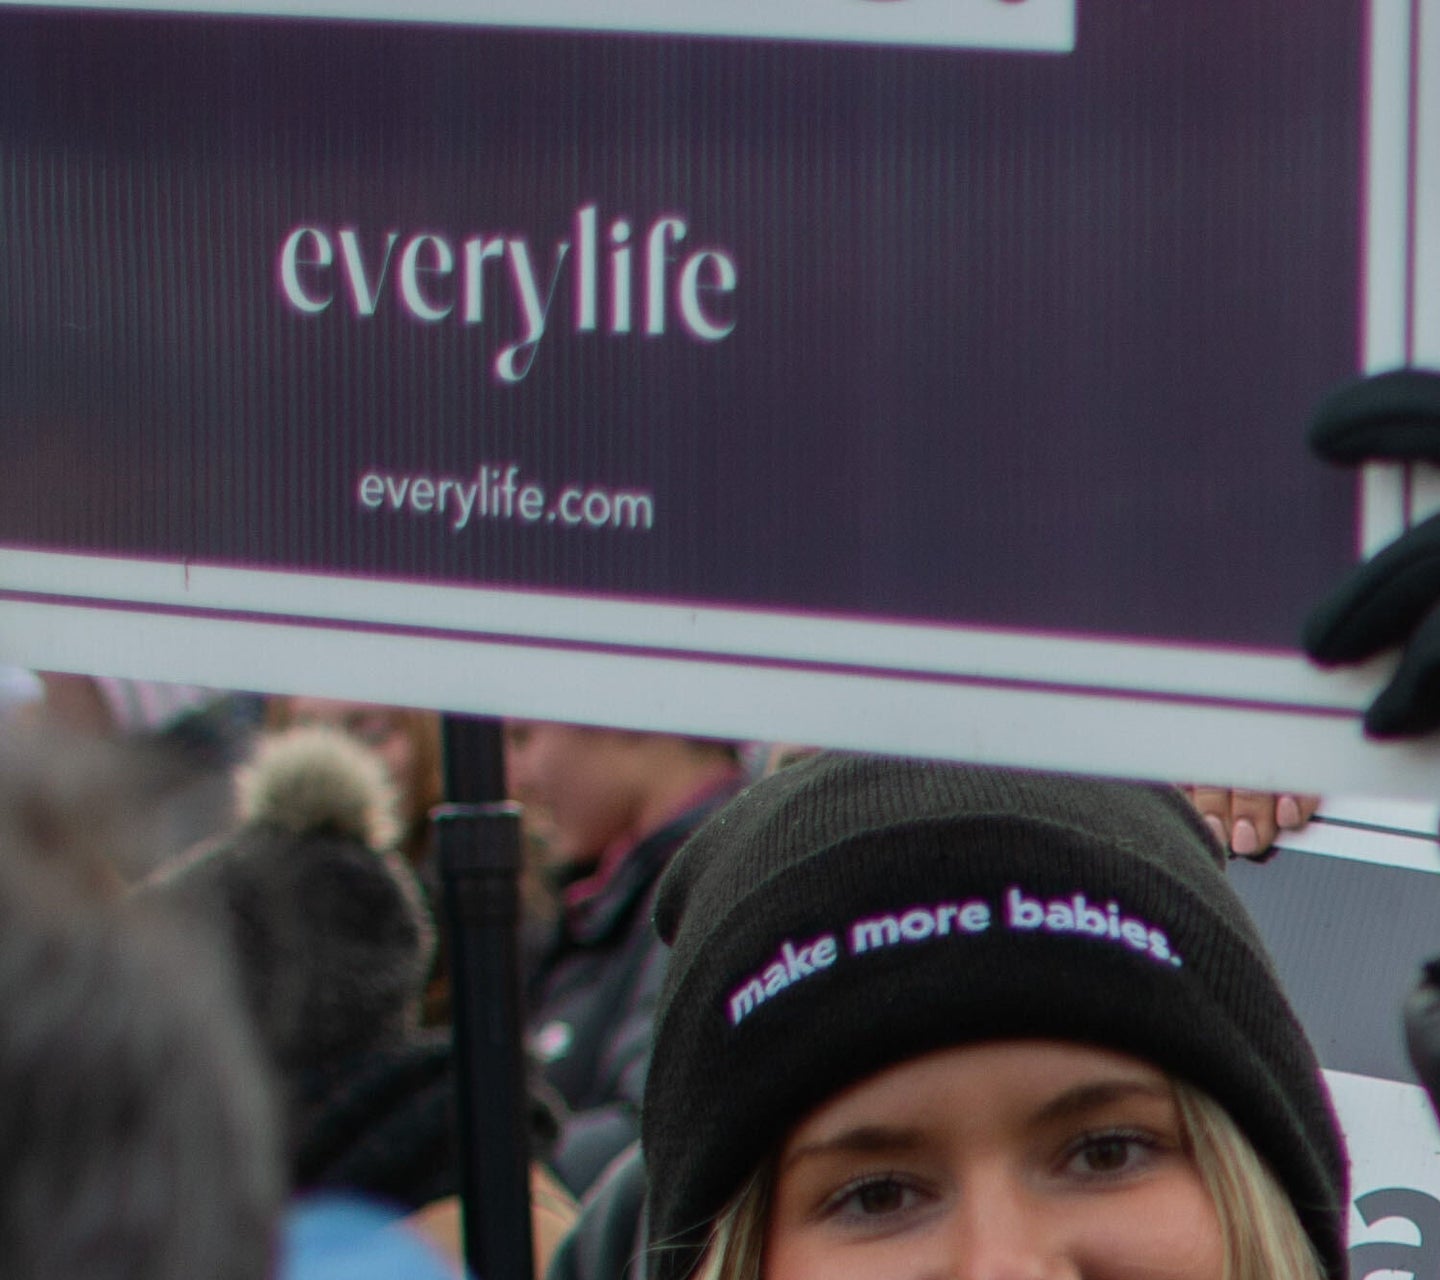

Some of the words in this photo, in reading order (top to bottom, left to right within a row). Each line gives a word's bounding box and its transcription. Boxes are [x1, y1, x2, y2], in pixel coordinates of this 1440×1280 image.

[280, 204, 737, 382] everylife
[359, 465, 654, 531] everylife.com
[728, 941, 838, 1026] make
[848, 899, 992, 954] more
[1007, 886, 1183, 968] babies.
